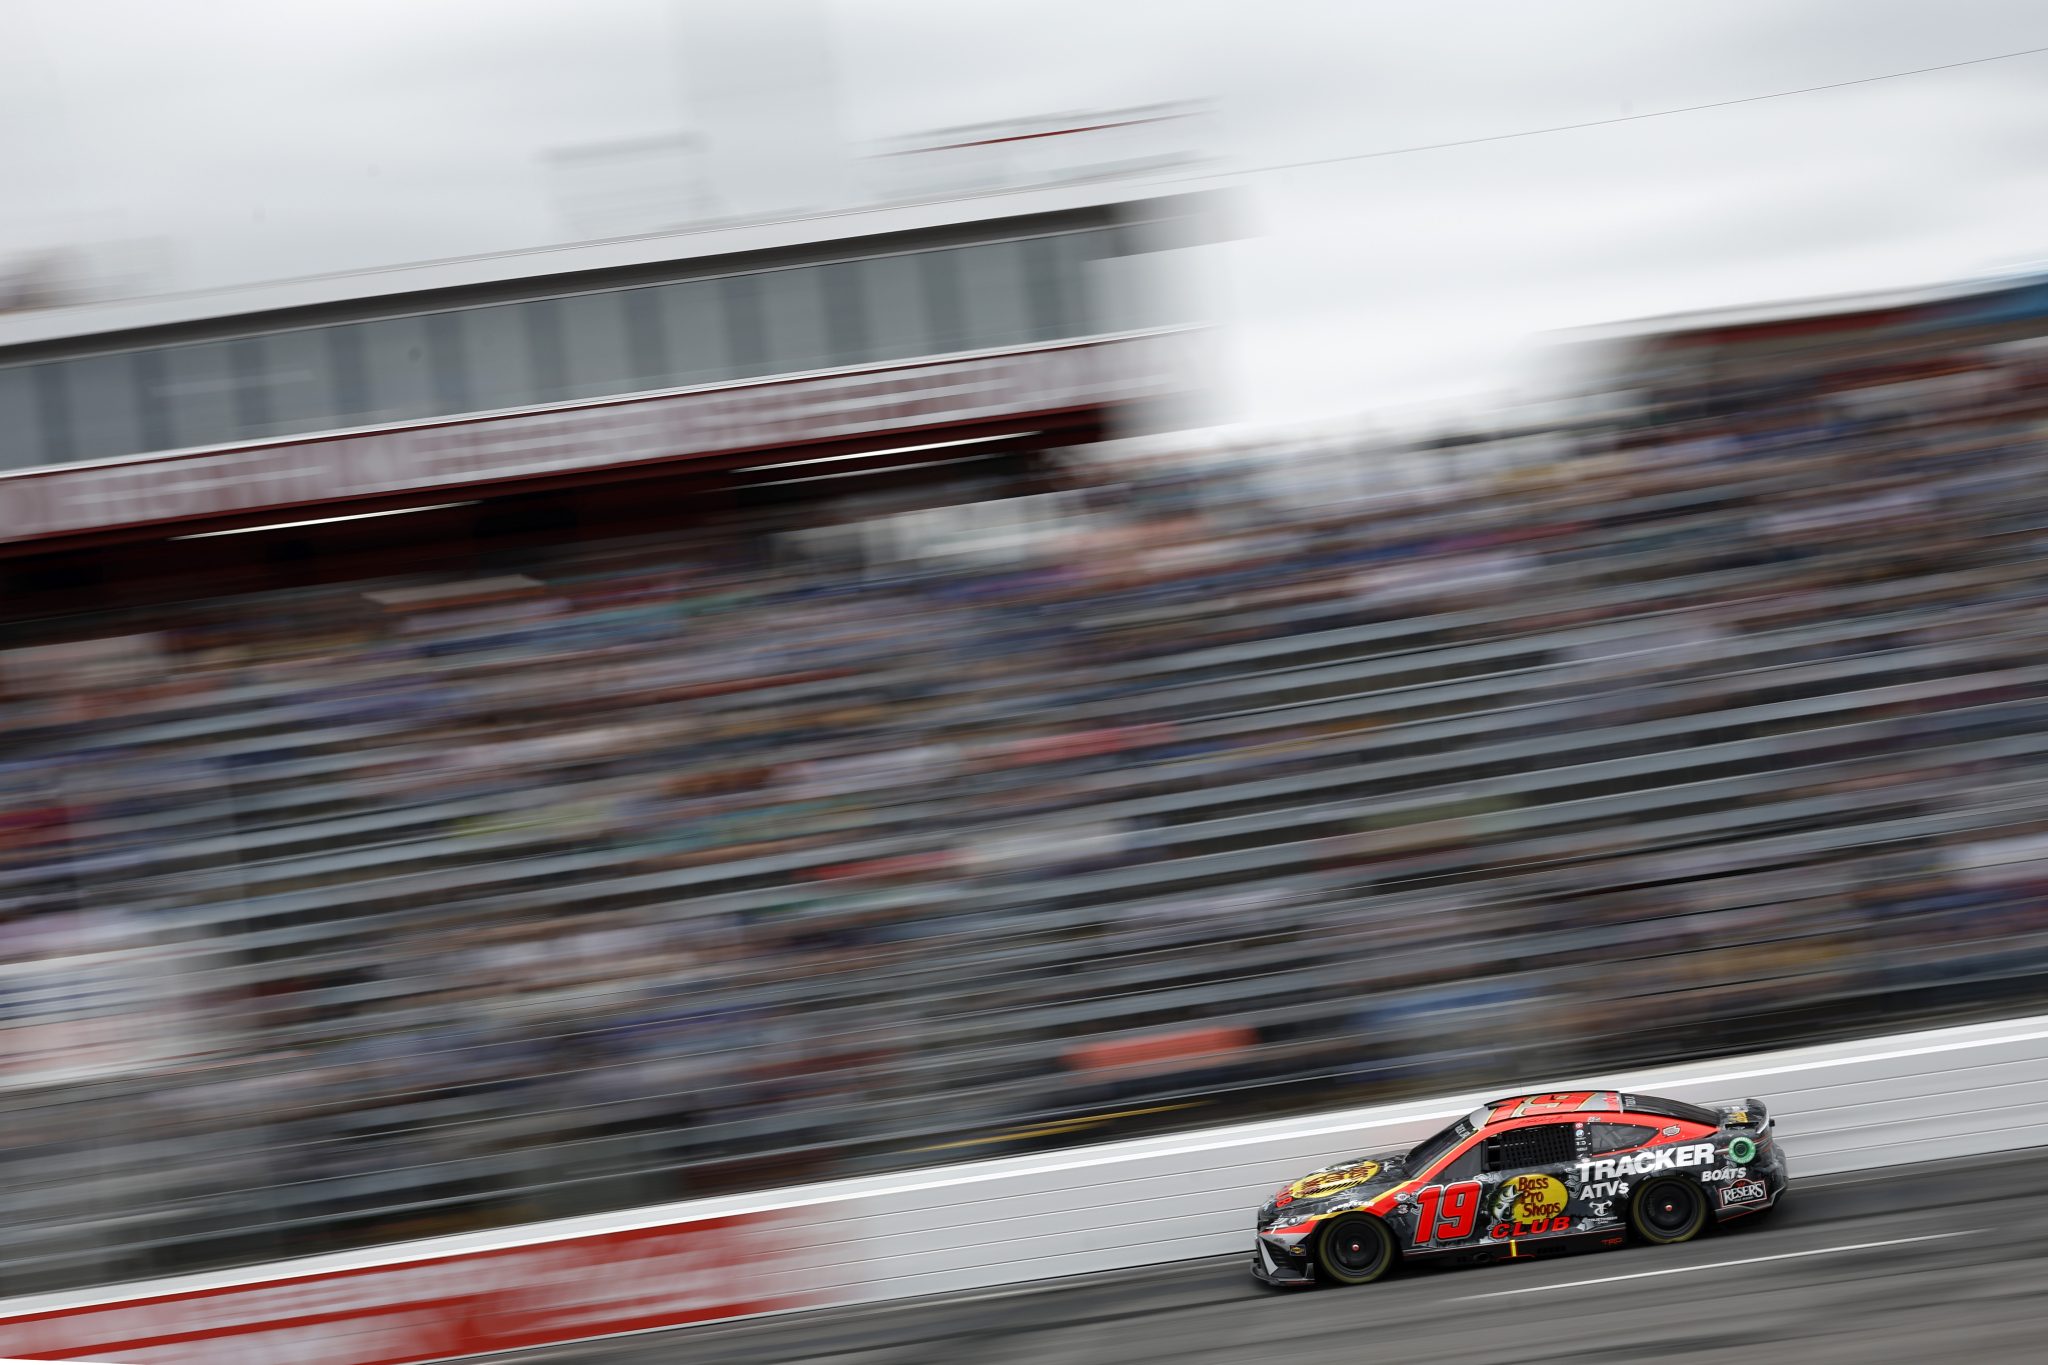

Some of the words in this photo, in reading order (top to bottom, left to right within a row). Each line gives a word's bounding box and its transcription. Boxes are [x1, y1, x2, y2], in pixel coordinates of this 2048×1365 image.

[1575, 1143, 1715, 1182] TRACKER
[1701, 1167, 1747, 1182] BOATS
[1518, 1177, 1549, 1191] Bass
[1580, 1180, 1630, 1201] ATVs
[1520, 1190, 1545, 1204] Pro
[1413, 1181, 1483, 1246] 19
[1522, 1202, 1561, 1218] Shops
[1492, 1216, 1571, 1239] CLUB
